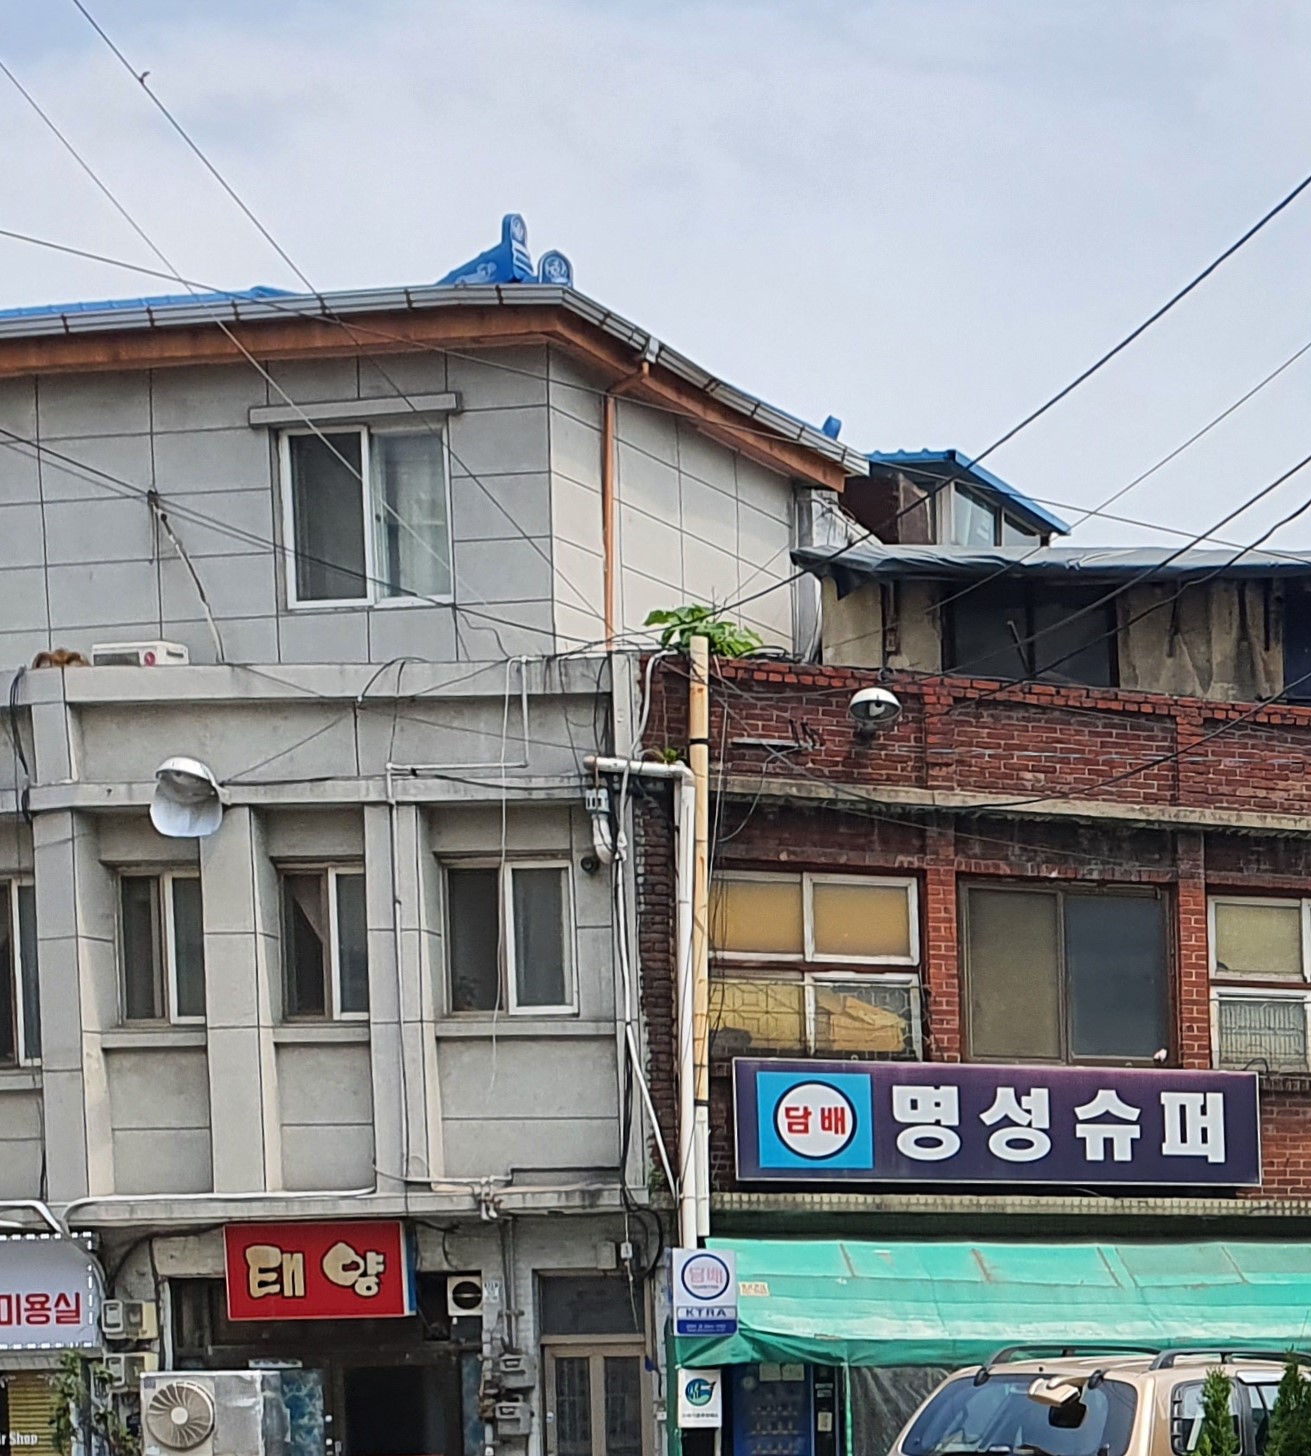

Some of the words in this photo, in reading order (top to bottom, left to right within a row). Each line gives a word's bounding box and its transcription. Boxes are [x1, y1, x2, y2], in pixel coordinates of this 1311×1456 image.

[785, 1106, 846, 1135] 담배
[891, 1085, 1226, 1164] 명성슈퍼
[245, 1241, 385, 1298] 태양
[0, 1292, 81, 1326] 미용실
[9, 1430, 38, 1446] Shop
